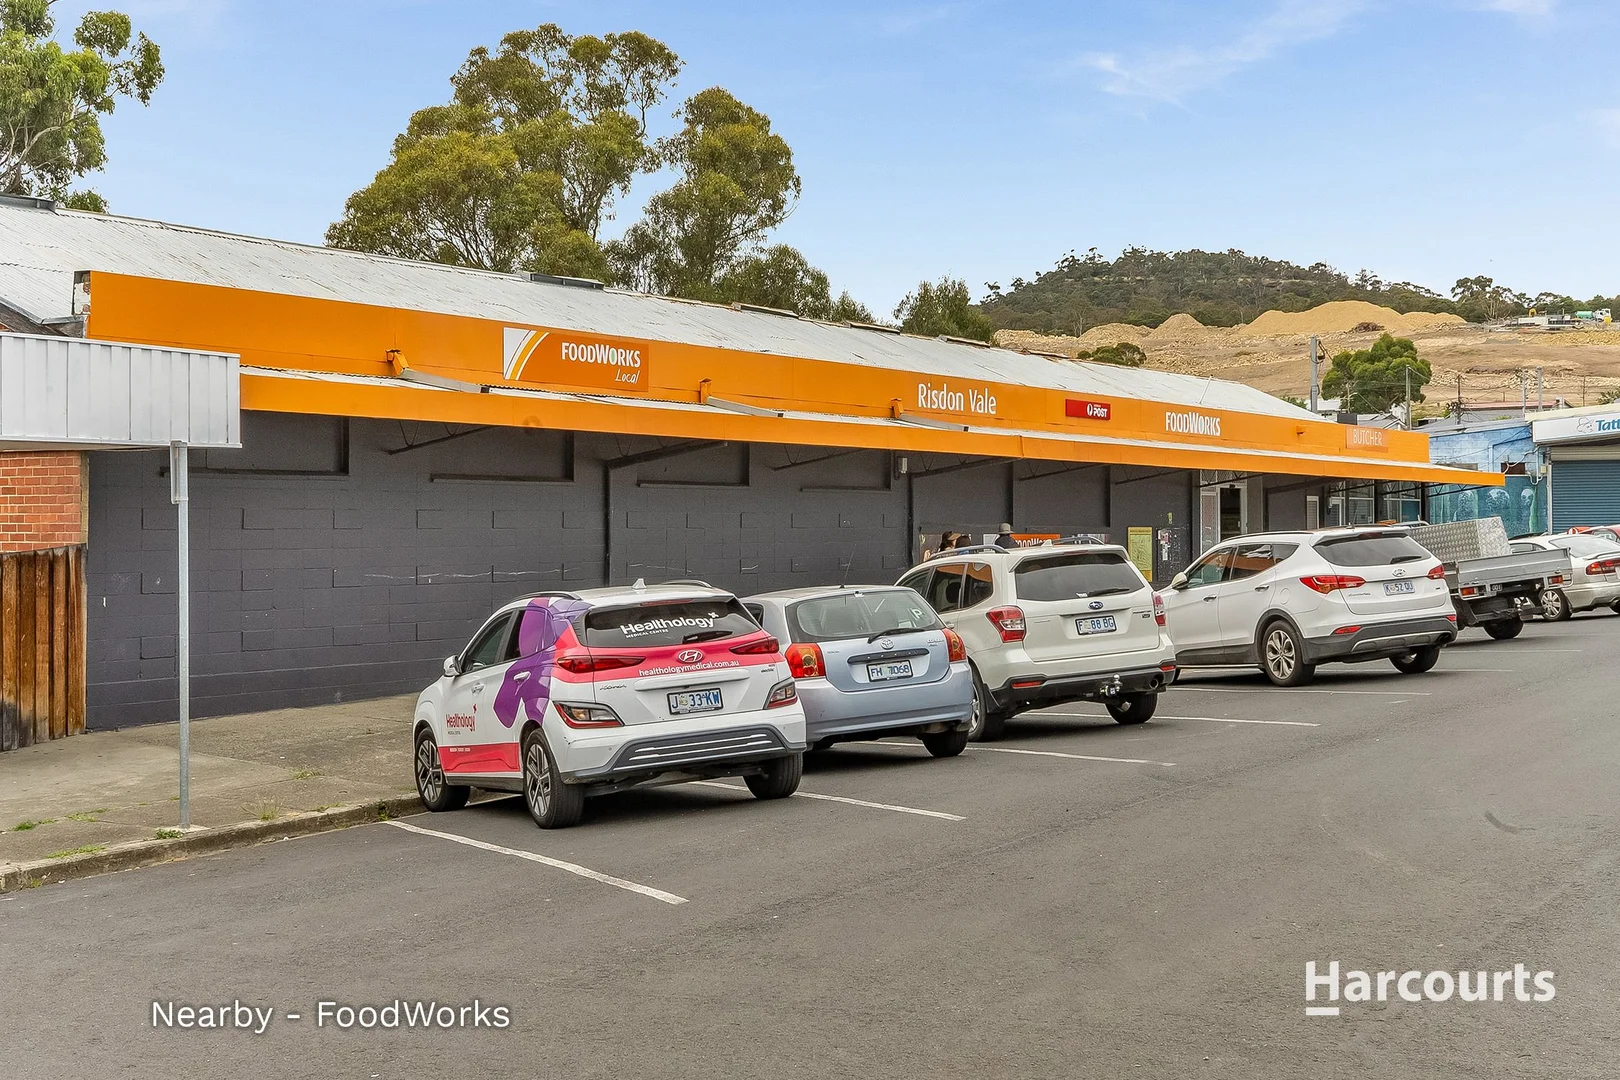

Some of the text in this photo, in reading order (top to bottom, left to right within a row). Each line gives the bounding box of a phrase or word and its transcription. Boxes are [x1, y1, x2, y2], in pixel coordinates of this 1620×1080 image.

[561, 342, 641, 368] FOODWORKS
[614, 368, 641, 385] Local
[917, 382, 997, 415] Risdon Vale
[1093, 407, 1108, 418] POST
[1165, 410, 1221, 437] FOODWORKS
[1352, 429, 1383, 446] BUTCHER
[620, 617, 714, 634] Healthology
[1090, 619, 1102, 630] 88
[638, 660, 740, 677] healthologymedical.com.au
[870, 667, 883, 677] FH
[671, 691, 720, 709] J 33 KW
[445, 713, 476, 732] Healthology
